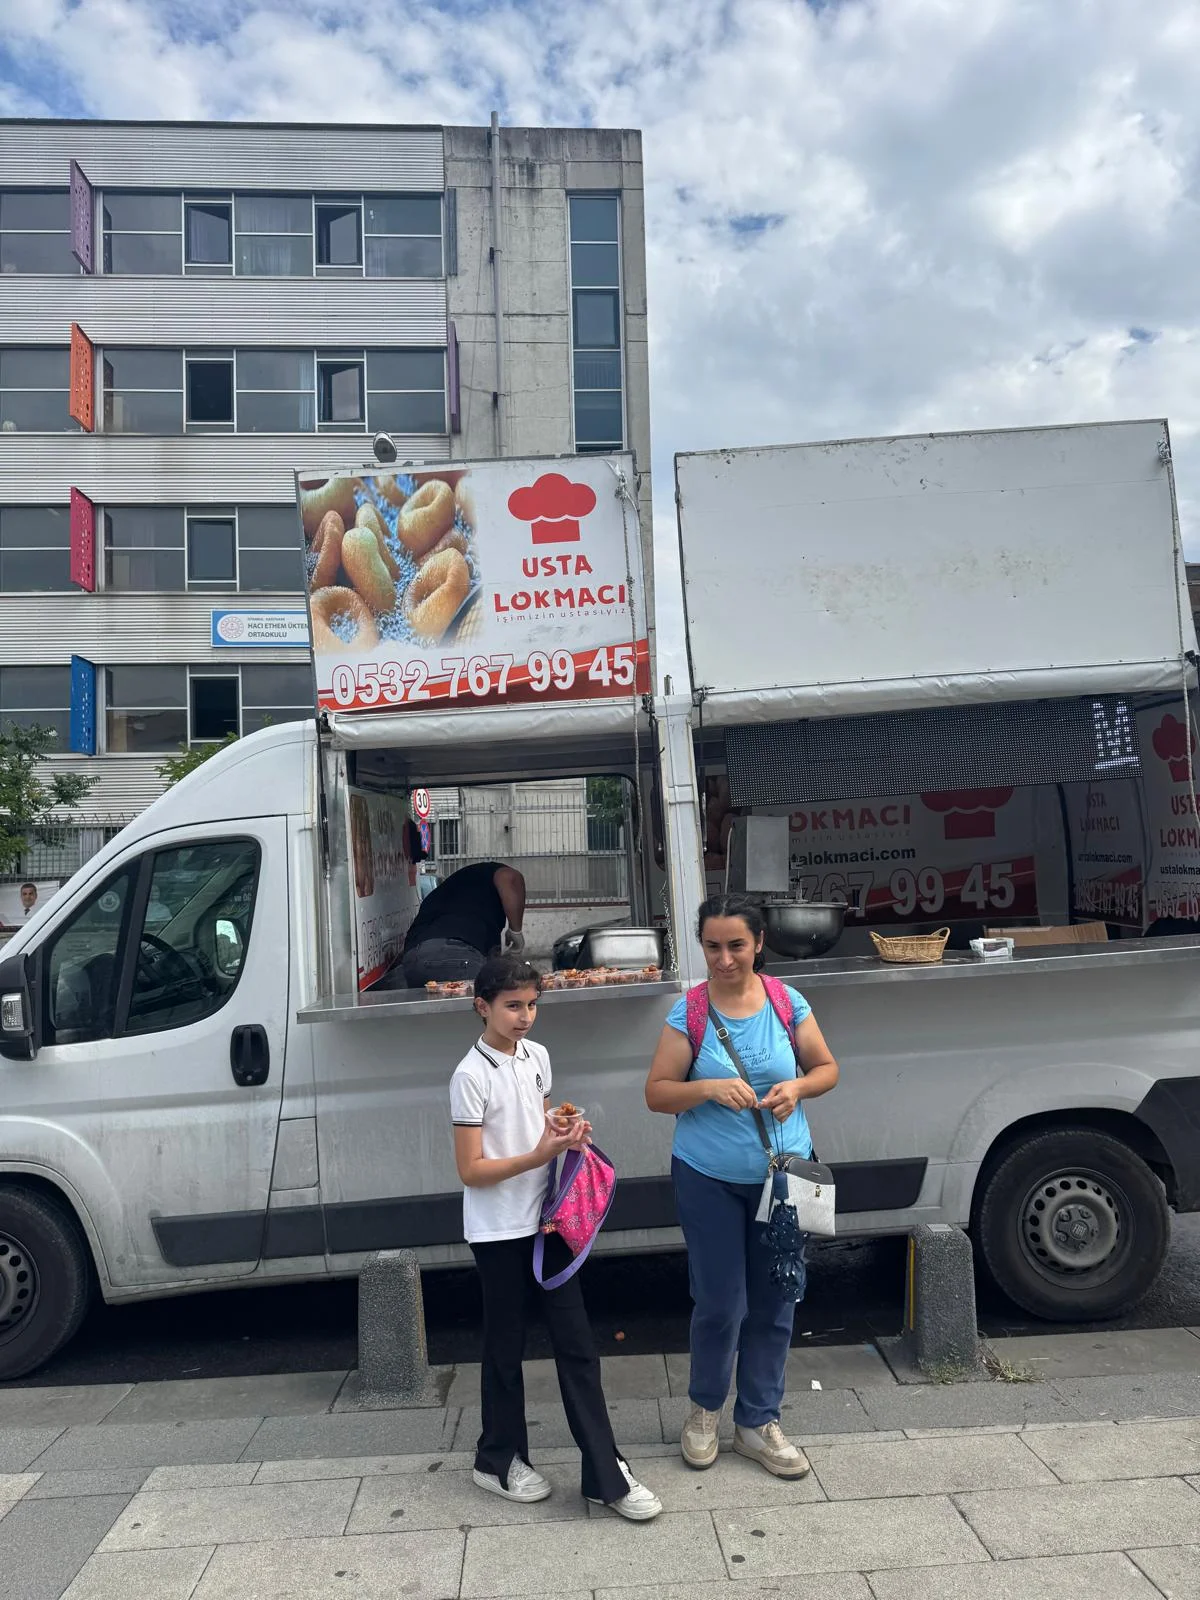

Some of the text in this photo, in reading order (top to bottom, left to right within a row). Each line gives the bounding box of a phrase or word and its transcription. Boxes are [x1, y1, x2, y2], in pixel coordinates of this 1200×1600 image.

[521, 554, 593, 578] USTA
[494, 584, 626, 613] LOKMACI
[332, 646, 636, 706] 0532 767 99 45
[417, 793, 427, 808] 30
[788, 804, 911, 833] OKMACI
[1160, 827, 1200, 849] LOKM
[889, 866, 945, 916] 99
[960, 862, 1016, 911] 45
